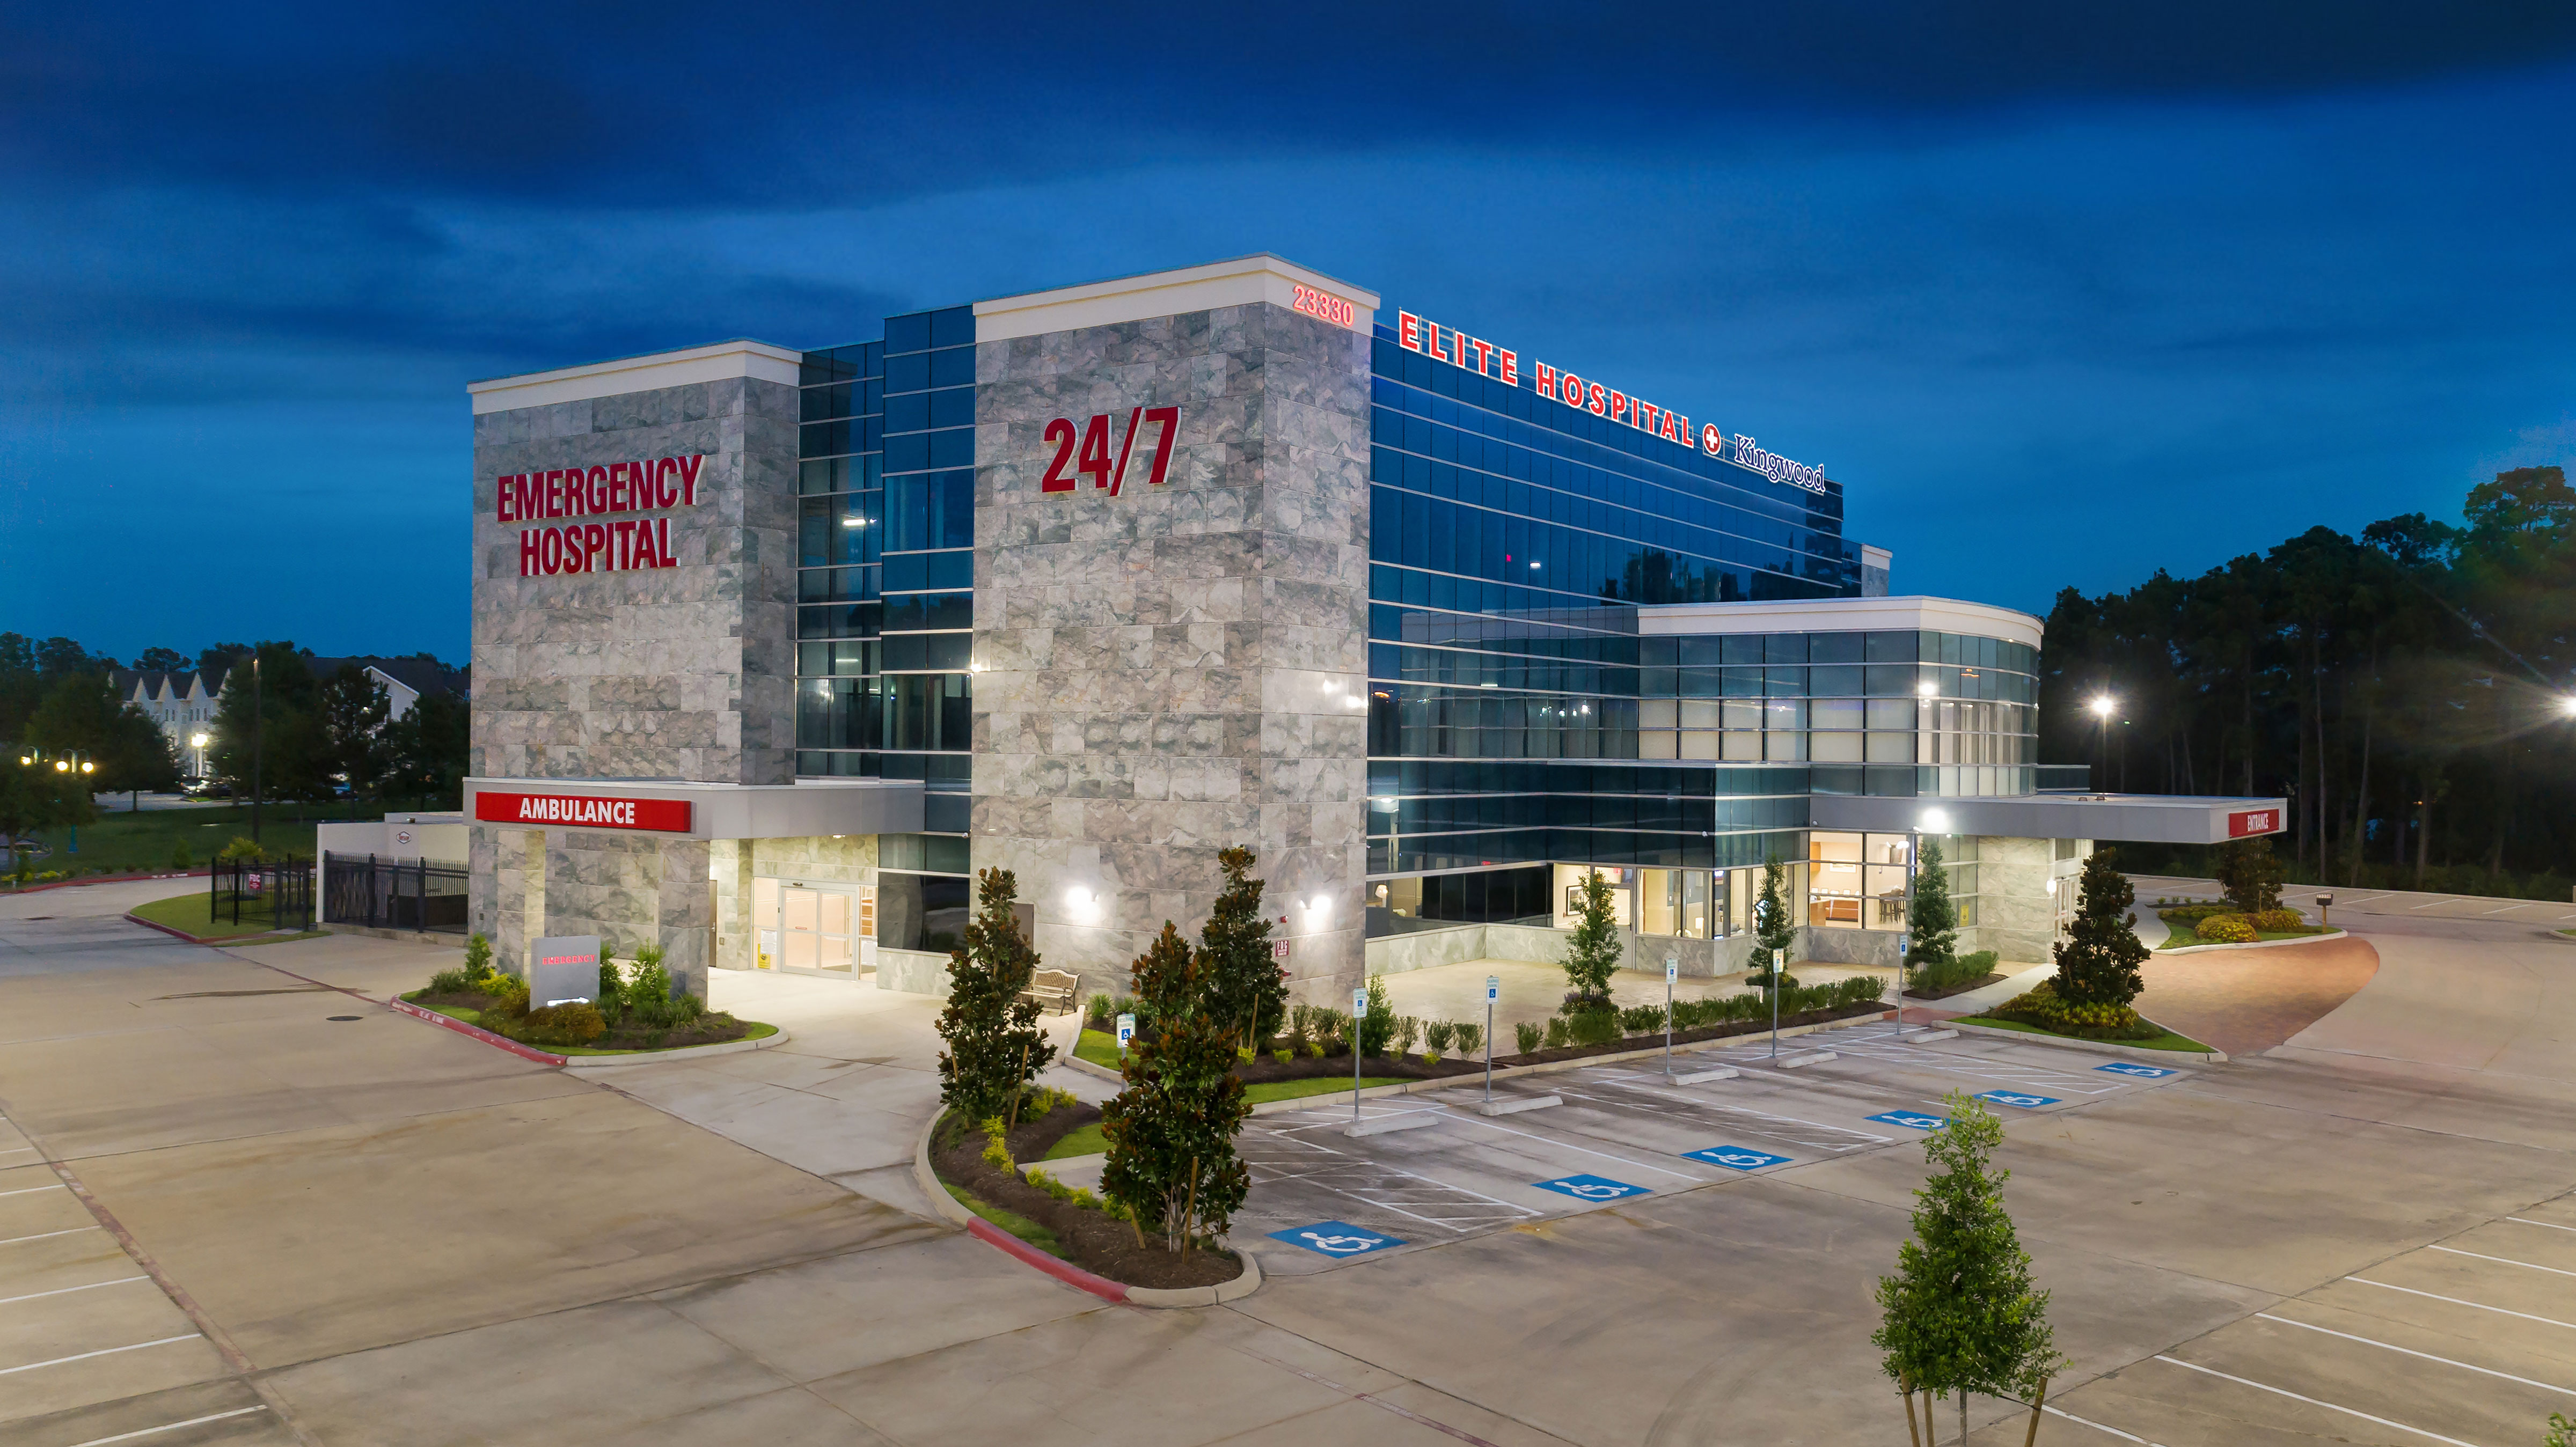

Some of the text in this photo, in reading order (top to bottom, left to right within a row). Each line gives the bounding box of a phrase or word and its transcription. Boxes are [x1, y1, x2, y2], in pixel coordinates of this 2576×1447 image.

[1293, 284, 1355, 326] 23330
[1399, 310, 1826, 492] ELITE HOSPITAL Kingwood
[1042, 406, 1182, 496] 24/7
[497, 454, 706, 522] EMERGENCY
[521, 518, 680, 577] HOSPITAL
[519, 797, 635, 824] AMBULANCE
[2247, 813, 2268, 832] ENTRANCE
[542, 954, 595, 965] EMERGENCY
[1277, 940, 1287, 950] FDC
